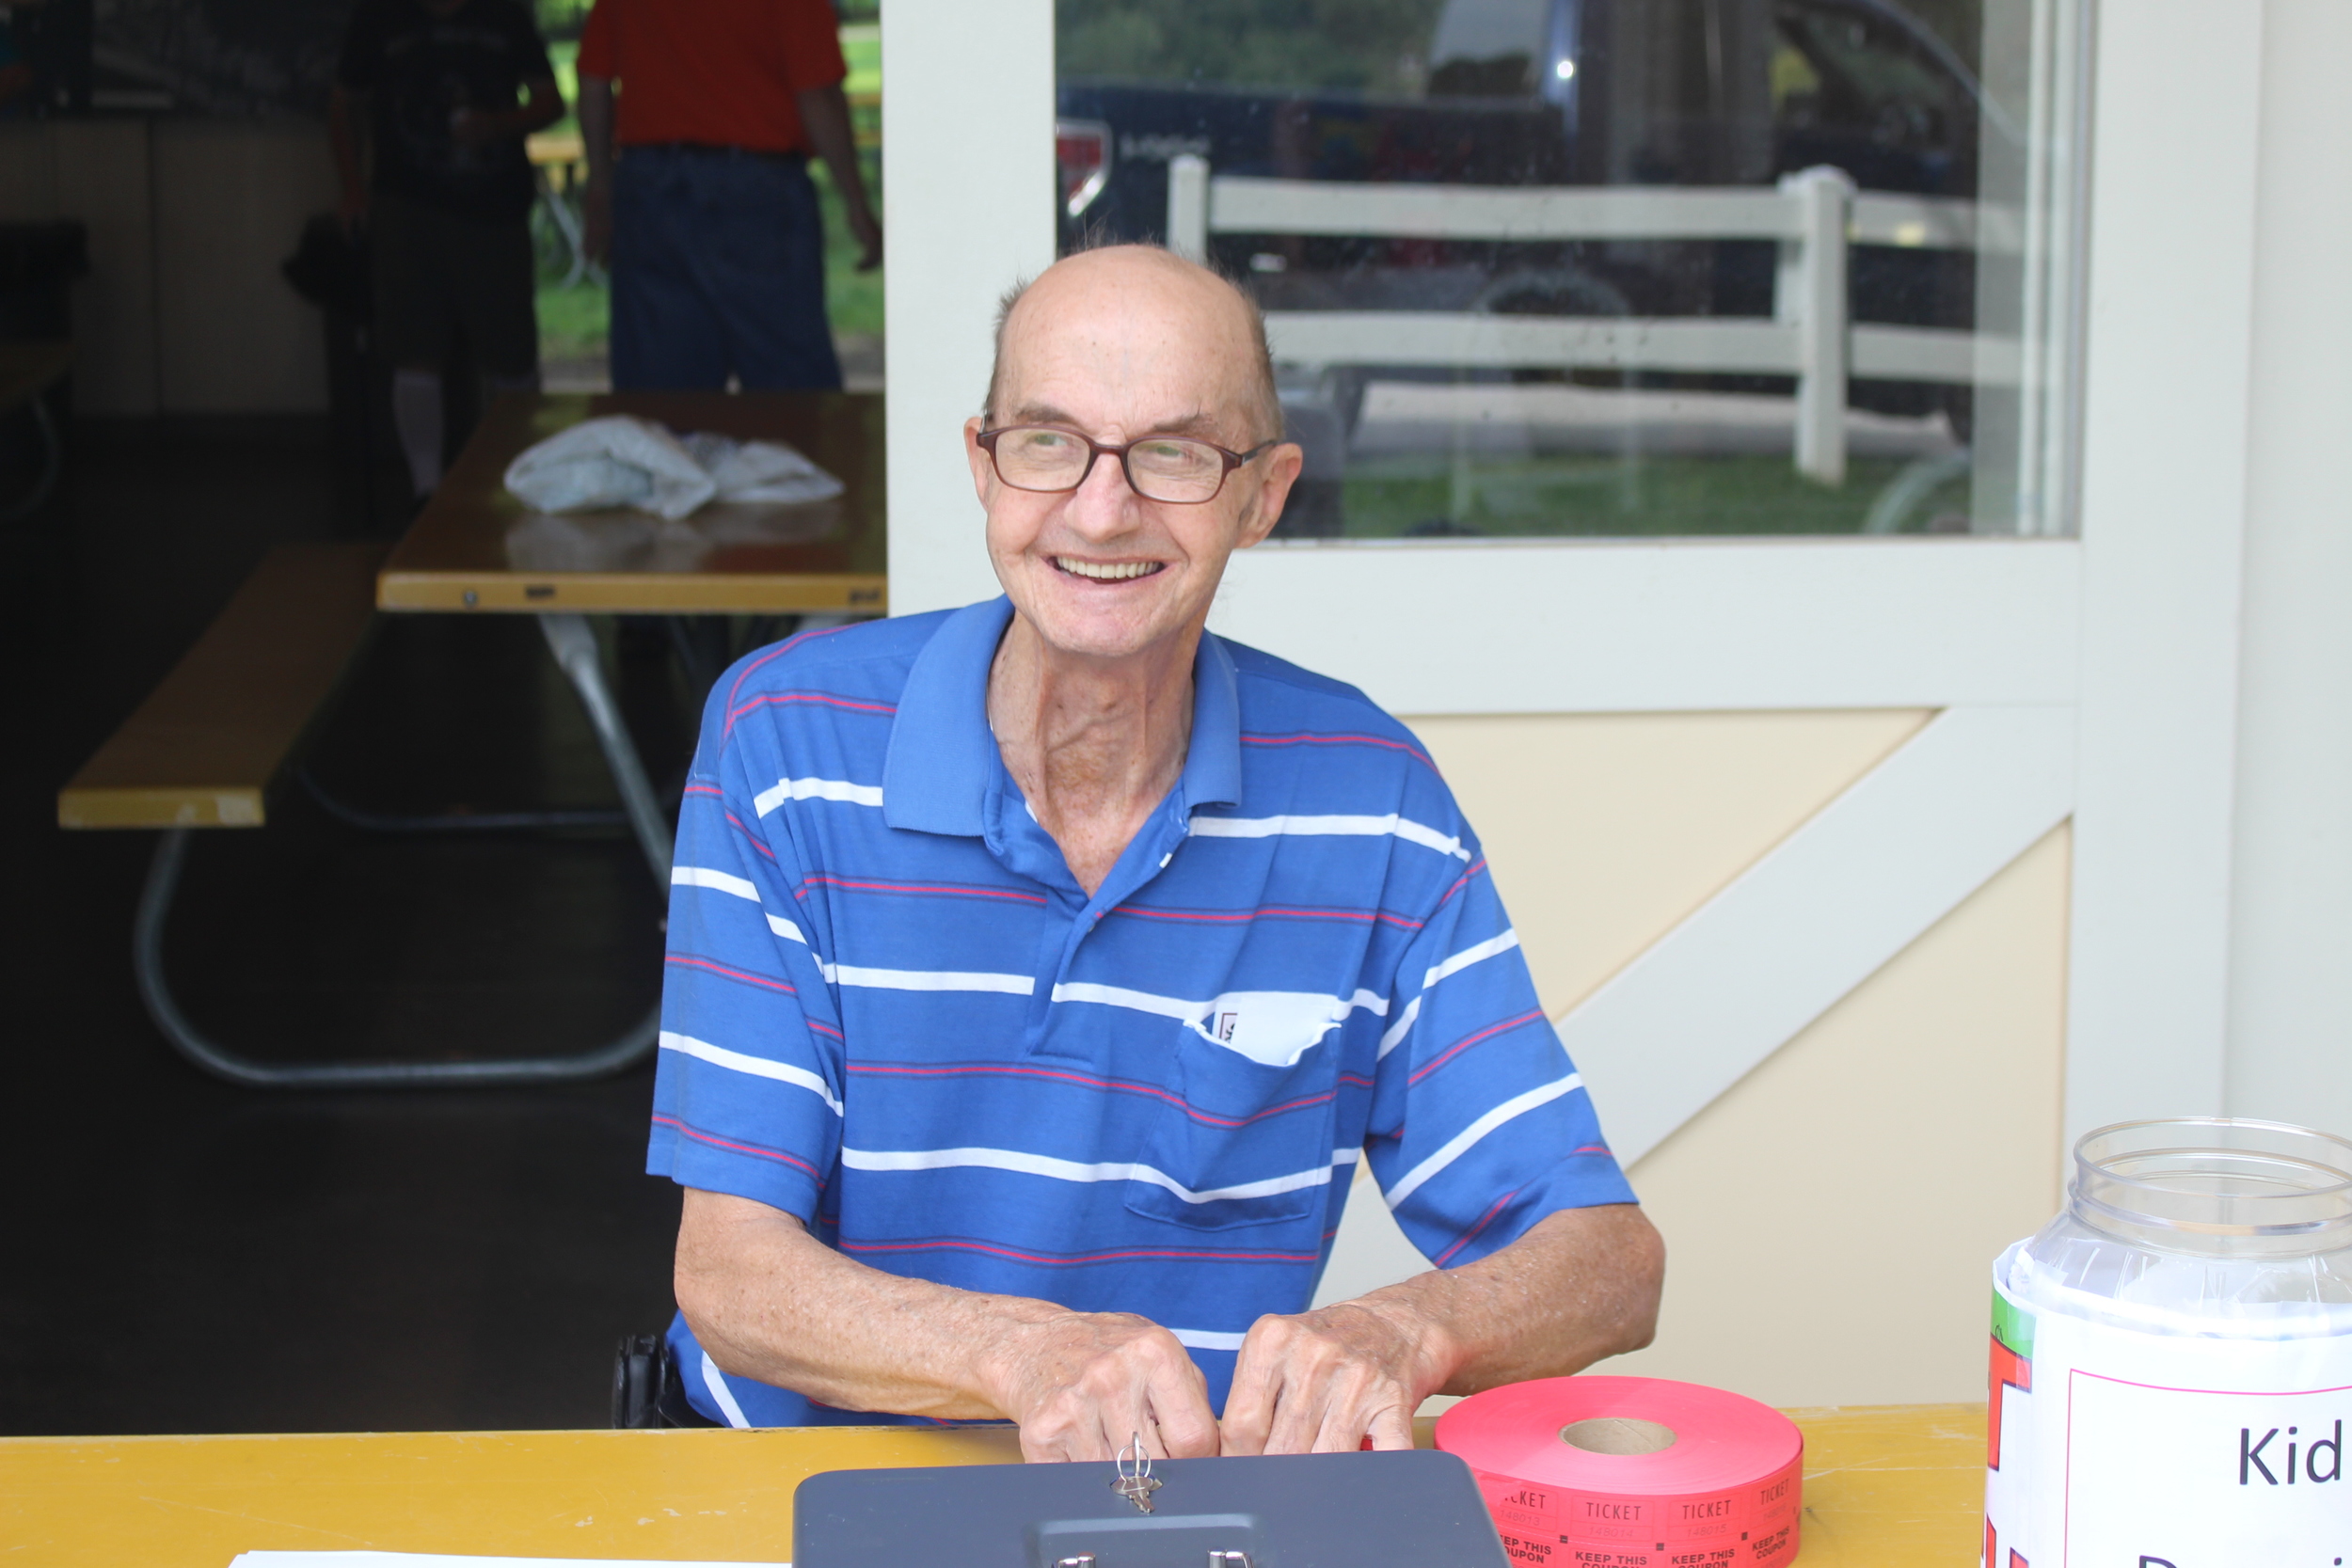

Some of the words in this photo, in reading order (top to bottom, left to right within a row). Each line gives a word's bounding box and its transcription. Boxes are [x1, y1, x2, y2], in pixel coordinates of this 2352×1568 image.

[1760, 1478, 1789, 1505] TICKET
[1586, 1502, 1642, 1521] TICKET
[1682, 1499, 1731, 1520] TICKET
[1500, 1510, 1540, 1526] 148013
[1588, 1527, 1634, 1538] 148014
[1687, 1524, 1727, 1537] 148015
[1523, 1541, 1551, 1555] THIS
[1752, 1535, 1774, 1551] KEEP
[1575, 1551, 1612, 1563] KEEP
[1616, 1555, 1647, 1565] THIS
[1672, 1553, 1705, 1565] KEEP
[1709, 1548, 1735, 1561] THIS
